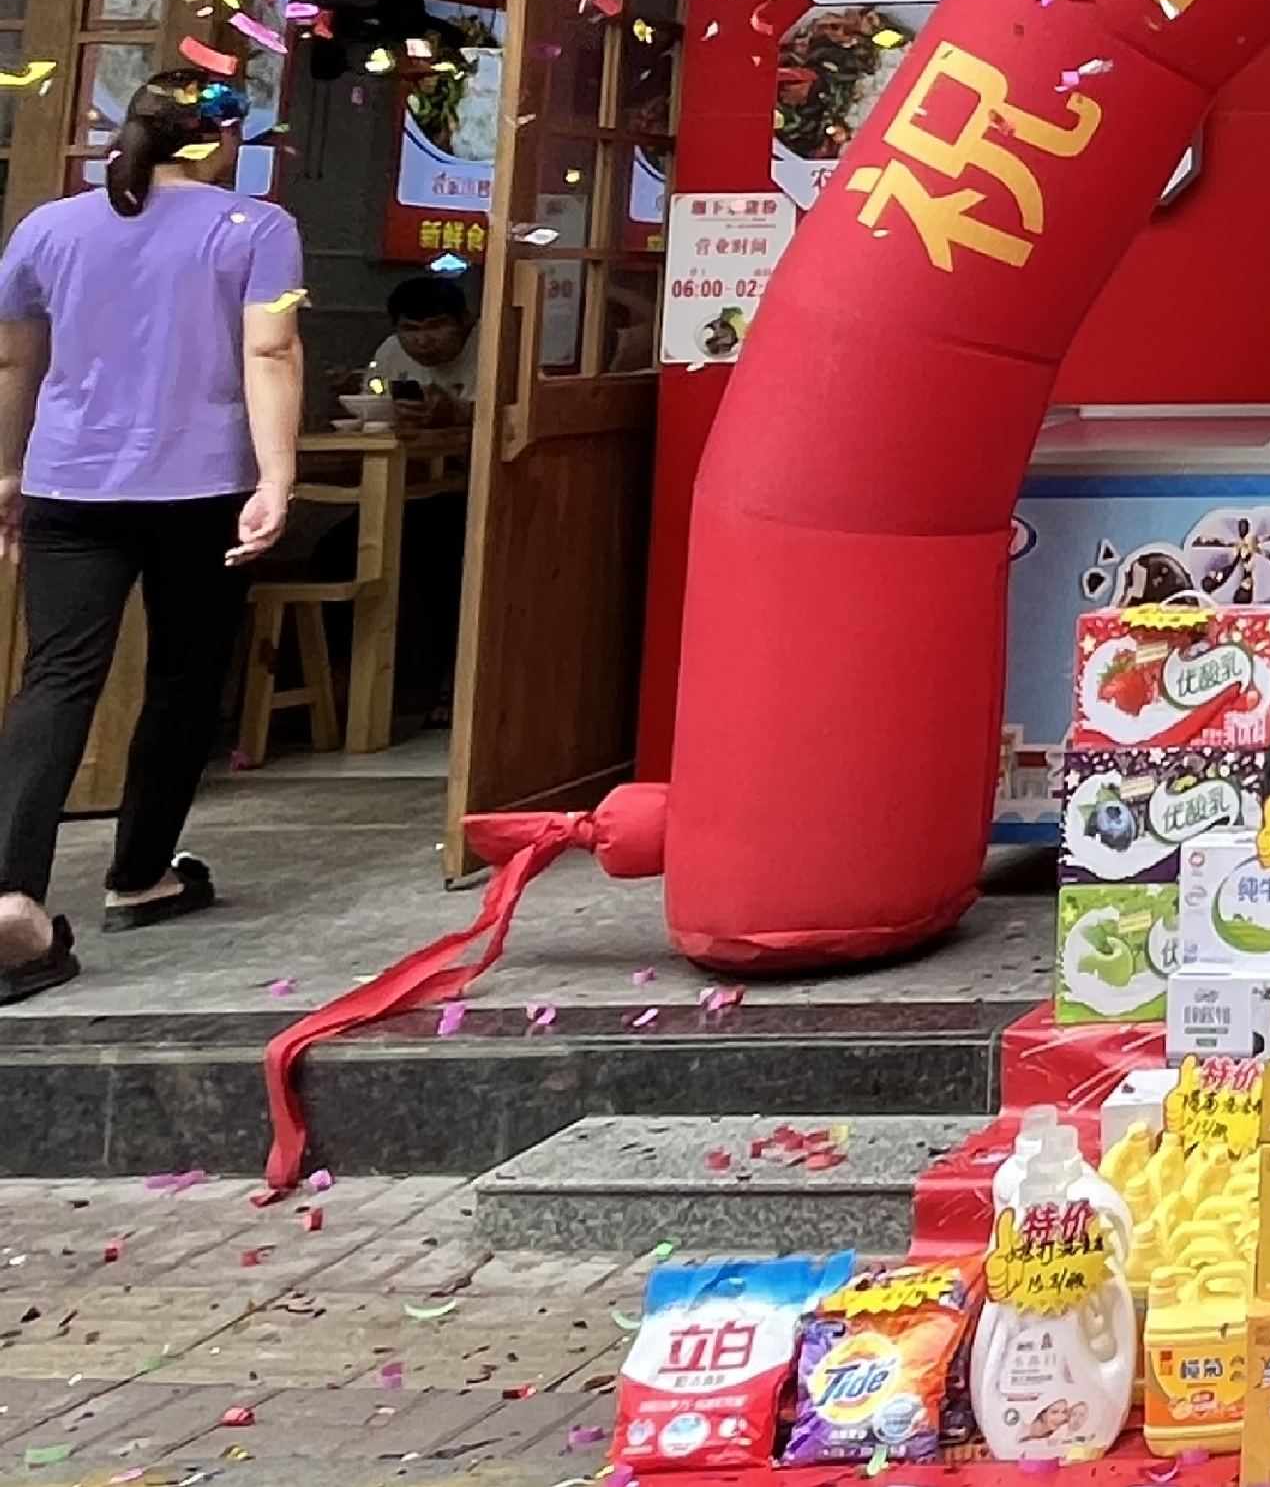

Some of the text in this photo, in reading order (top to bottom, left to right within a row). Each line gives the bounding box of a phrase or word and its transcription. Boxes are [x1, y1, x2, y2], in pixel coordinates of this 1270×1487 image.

[845, 39, 1103, 273] 祝
[1202, 1055, 1262, 1093] 特价
[1022, 1198, 1097, 1244] 特价
[657, 1320, 758, 1375] 立白
[816, 1362, 891, 1407] Tide
